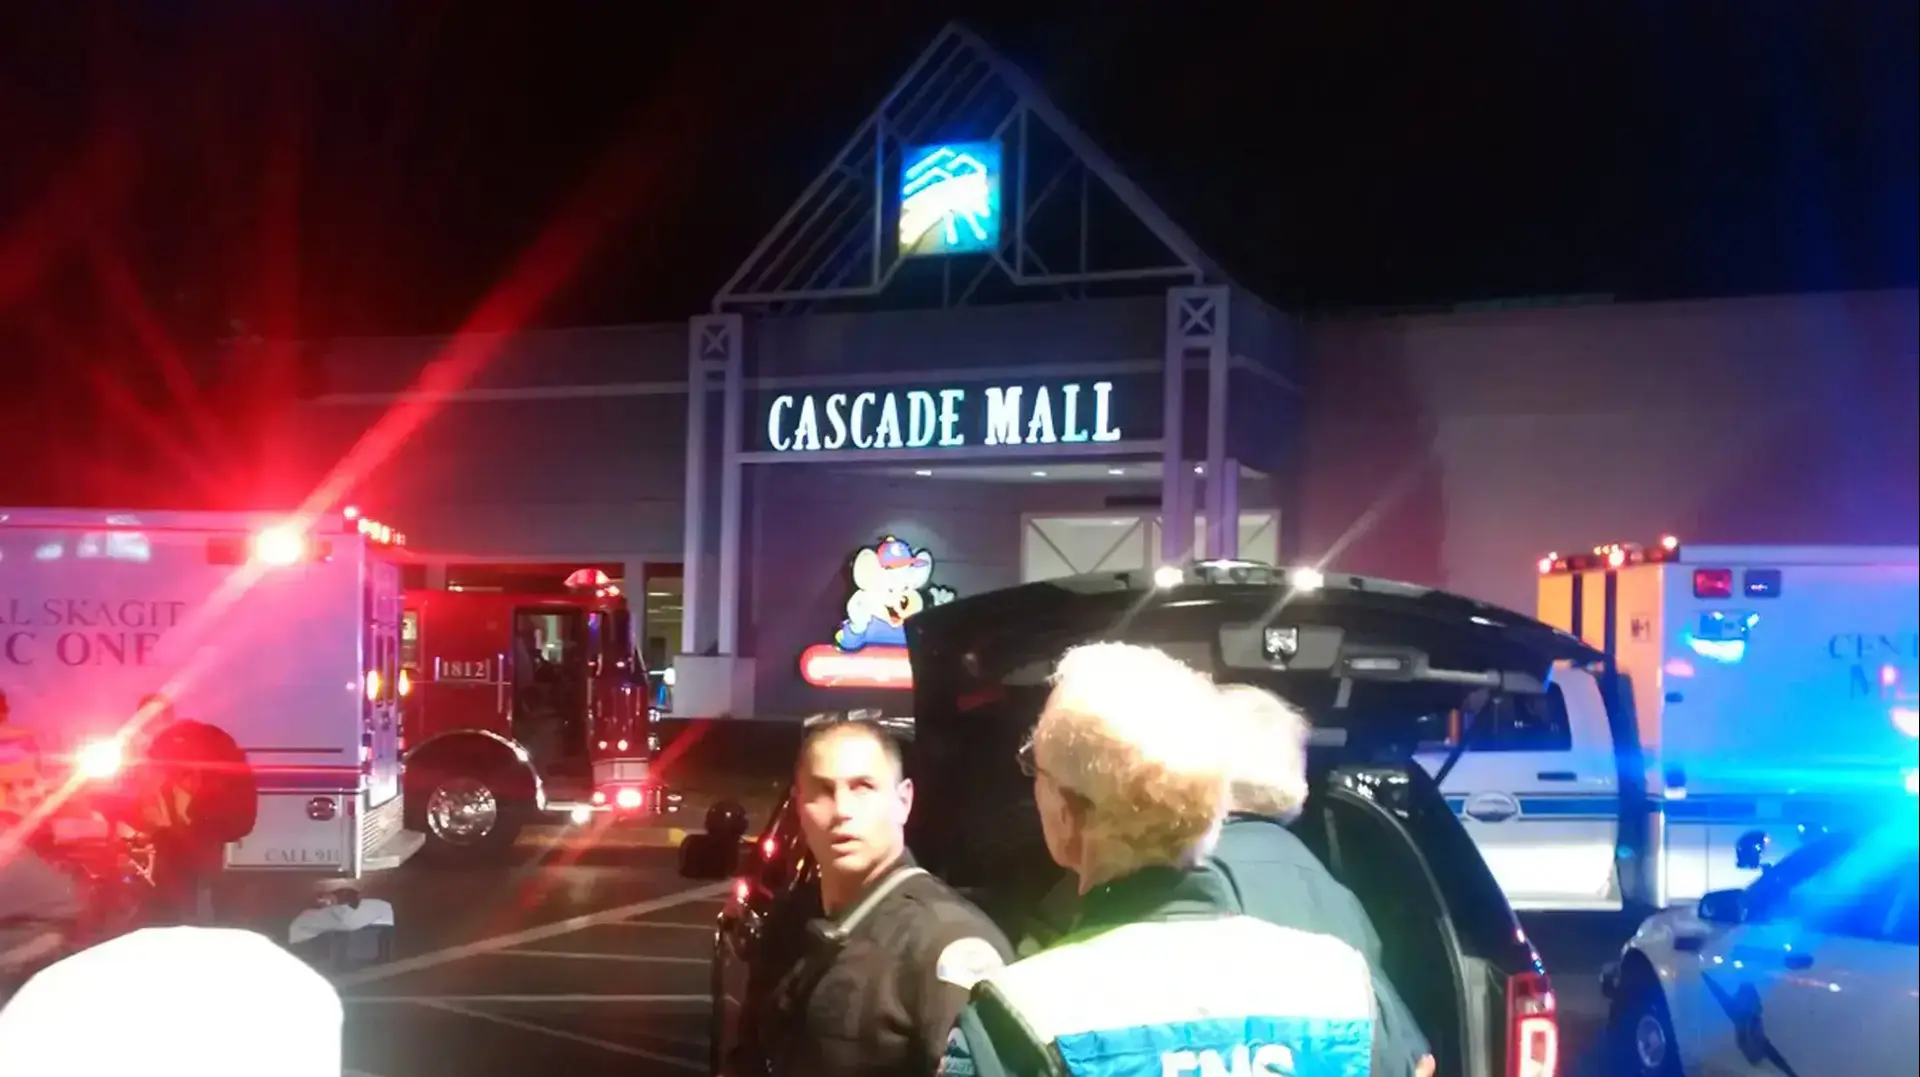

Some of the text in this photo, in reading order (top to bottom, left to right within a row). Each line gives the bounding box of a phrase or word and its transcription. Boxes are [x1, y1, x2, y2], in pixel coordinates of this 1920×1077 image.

[768, 382, 1121, 451] CASCADE MALL
[0, 598, 186, 627] L SKAGIT
[443, 661, 485, 677] 1812
[264, 848, 313, 863] CALL
